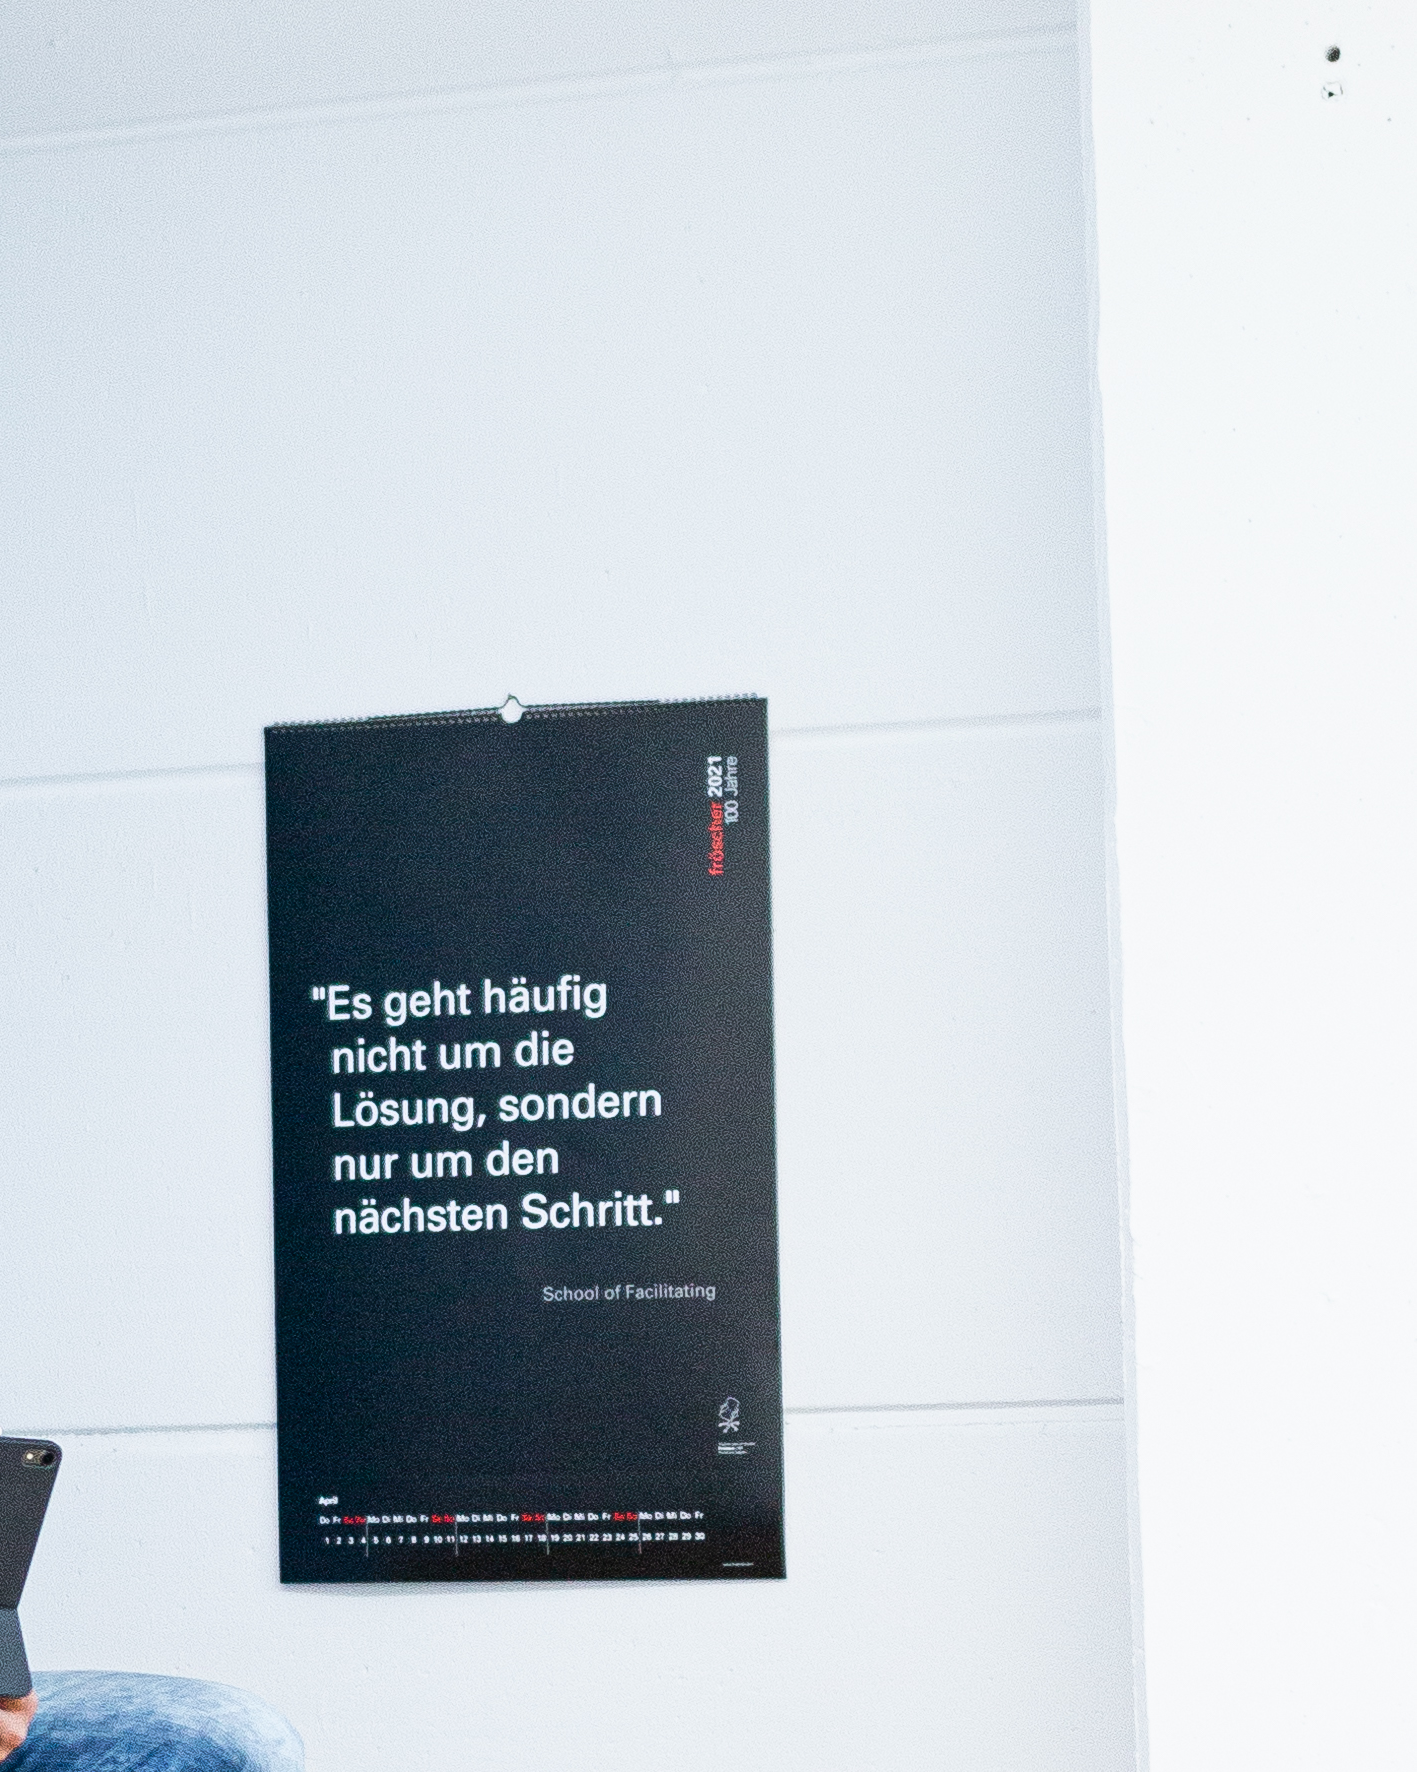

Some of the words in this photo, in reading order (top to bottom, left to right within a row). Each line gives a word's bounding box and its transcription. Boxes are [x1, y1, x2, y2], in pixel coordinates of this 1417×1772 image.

[707, 756, 722, 797] 2021
[724, 756, 738, 796] Jahre
[724, 800, 738, 824] 100
[708, 801, 723, 875] fröscher
[312, 985, 372, 1020] "Es
[384, 981, 471, 1026] geht
[483, 974, 607, 1018] häufig
[332, 1036, 427, 1074] nicht
[439, 1041, 501, 1070] um
[513, 1030, 574, 1067] die
[333, 1090, 486, 1131] Lösung,
[499, 1083, 662, 1122] sondern
[334, 1152, 400, 1181] nur
[411, 1150, 472, 1179] um
[486, 1140, 559, 1176] den
[334, 1197, 508, 1234] nächsten
[521, 1189, 680, 1229] Schritt."
[543, 1284, 600, 1302] School
[604, 1284, 622, 1300] of
[626, 1282, 717, 1301] Facilitating
